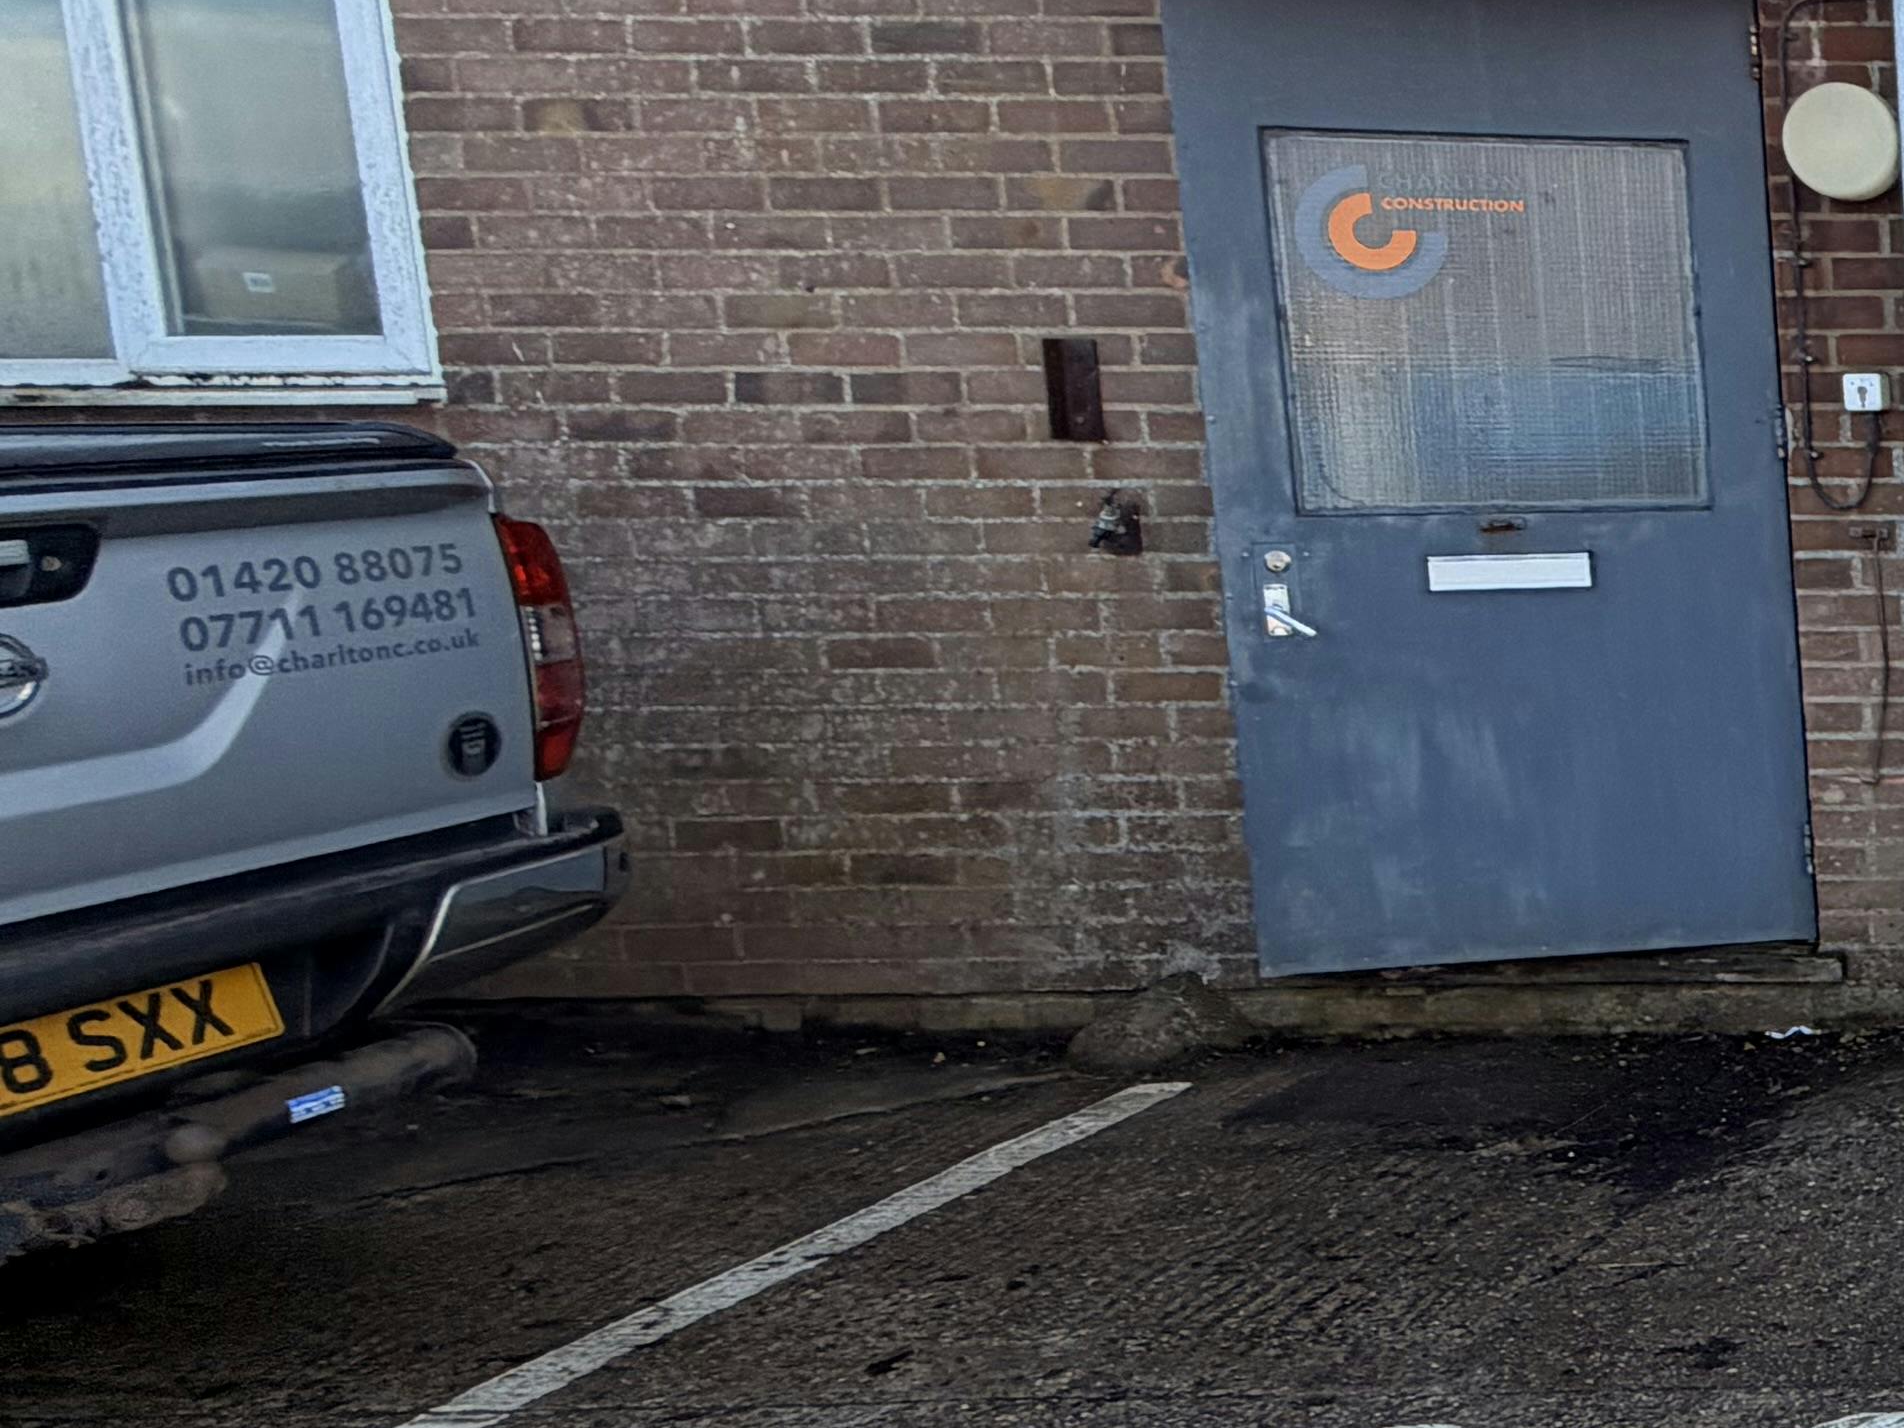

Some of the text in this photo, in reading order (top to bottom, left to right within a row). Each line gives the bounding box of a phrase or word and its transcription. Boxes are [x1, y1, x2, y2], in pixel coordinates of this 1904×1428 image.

[1381, 197, 1525, 212] CONSTRUCTION
[167, 543, 463, 602] 01420 88075
[180, 587, 477, 652] 07711 169481
[185, 628, 480, 686] info@charltonc.co.uk
[66, 979, 235, 1072] SXX
